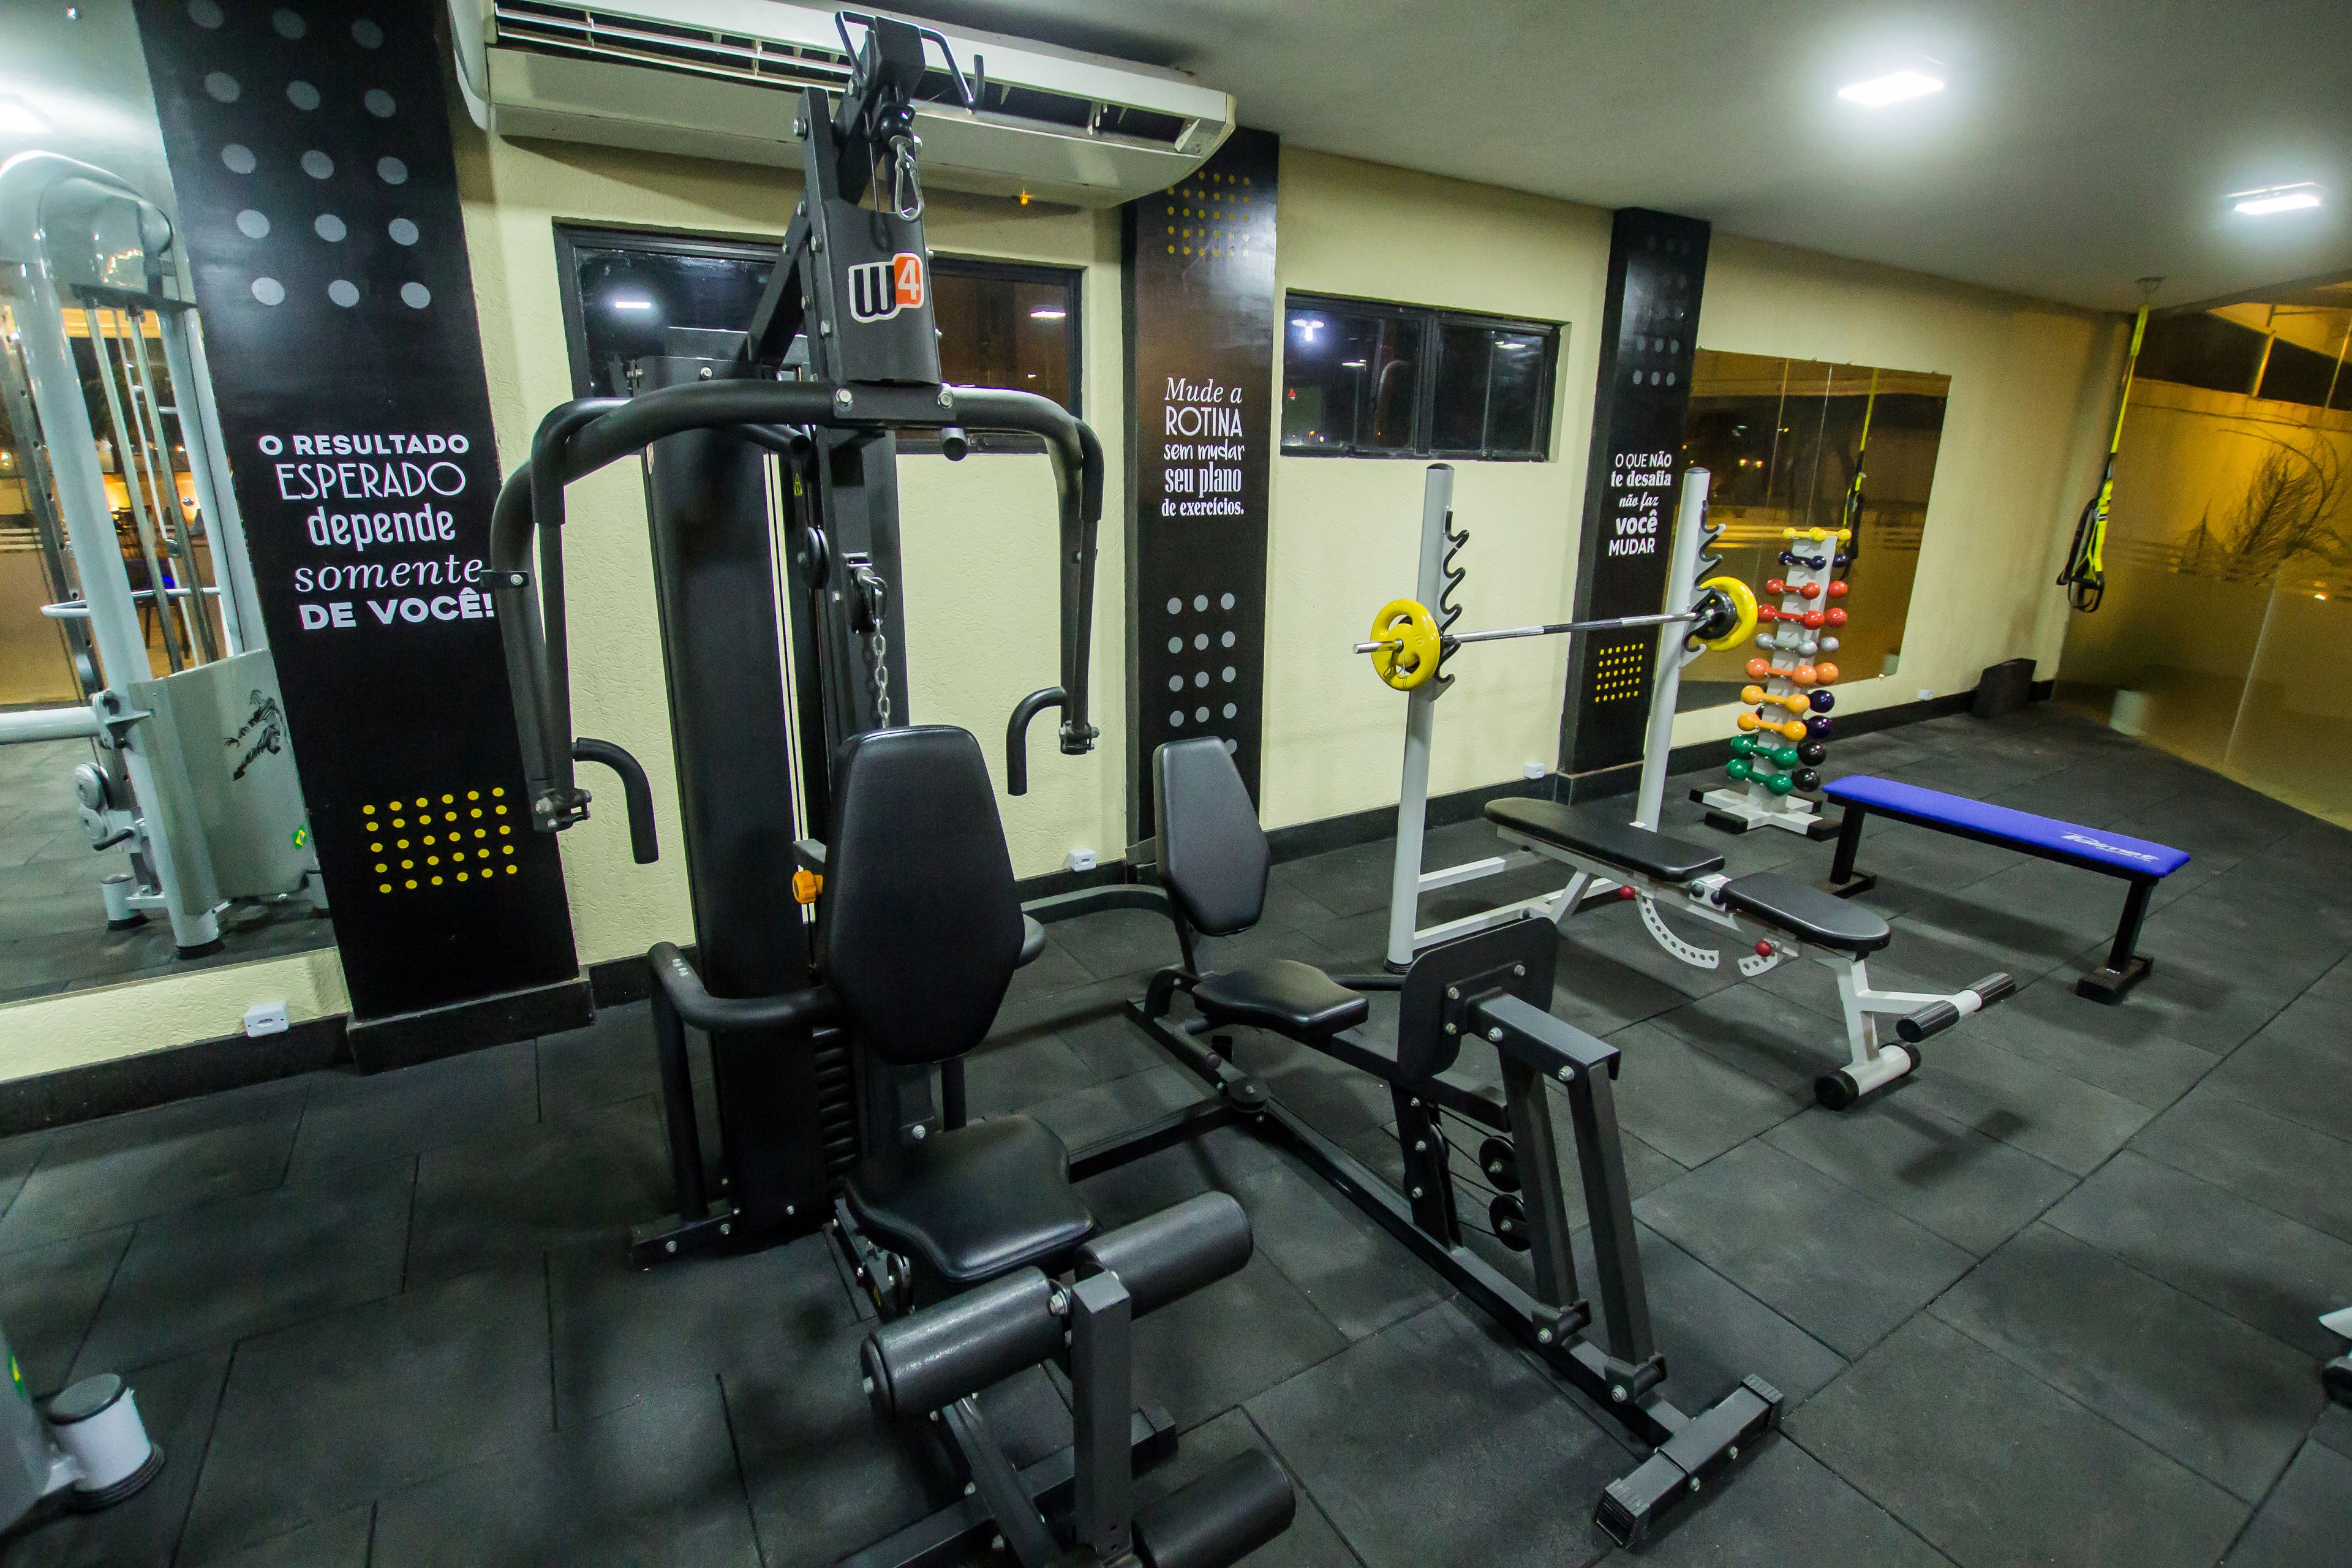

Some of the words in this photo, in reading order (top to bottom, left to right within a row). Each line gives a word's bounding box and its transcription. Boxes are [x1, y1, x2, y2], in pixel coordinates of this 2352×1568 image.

[1164, 377, 1224, 402] Mude
[1230, 386, 1242, 404] a
[1166, 405, 1243, 437] ROTINA
[259, 434, 283, 455] O
[293, 434, 470, 455] RESULTADO
[1164, 443, 1193, 460] sem
[1198, 438, 1245, 461] mudar
[1615, 453, 1624, 468] O
[1626, 453, 1648, 469] QUE
[1649, 450, 1672, 468] NÃO
[276, 461, 466, 500] ESPERADO
[1165, 468, 1194, 492] seu
[1199, 461, 1242, 499] plano
[1611, 470, 1623, 487] te
[1626, 470, 1672, 487] desafia
[1161, 498, 1176, 516] de
[1180, 497, 1245, 516] exercícios.
[1619, 494, 1638, 508] não
[1639, 491, 1659, 511] faz
[307, 503, 456, 551] depende
[1608, 537, 1656, 557] MUDAR
[294, 554, 483, 593] somente
[298, 601, 357, 631] DE
[368, 586, 495, 625] VOCÊ!
